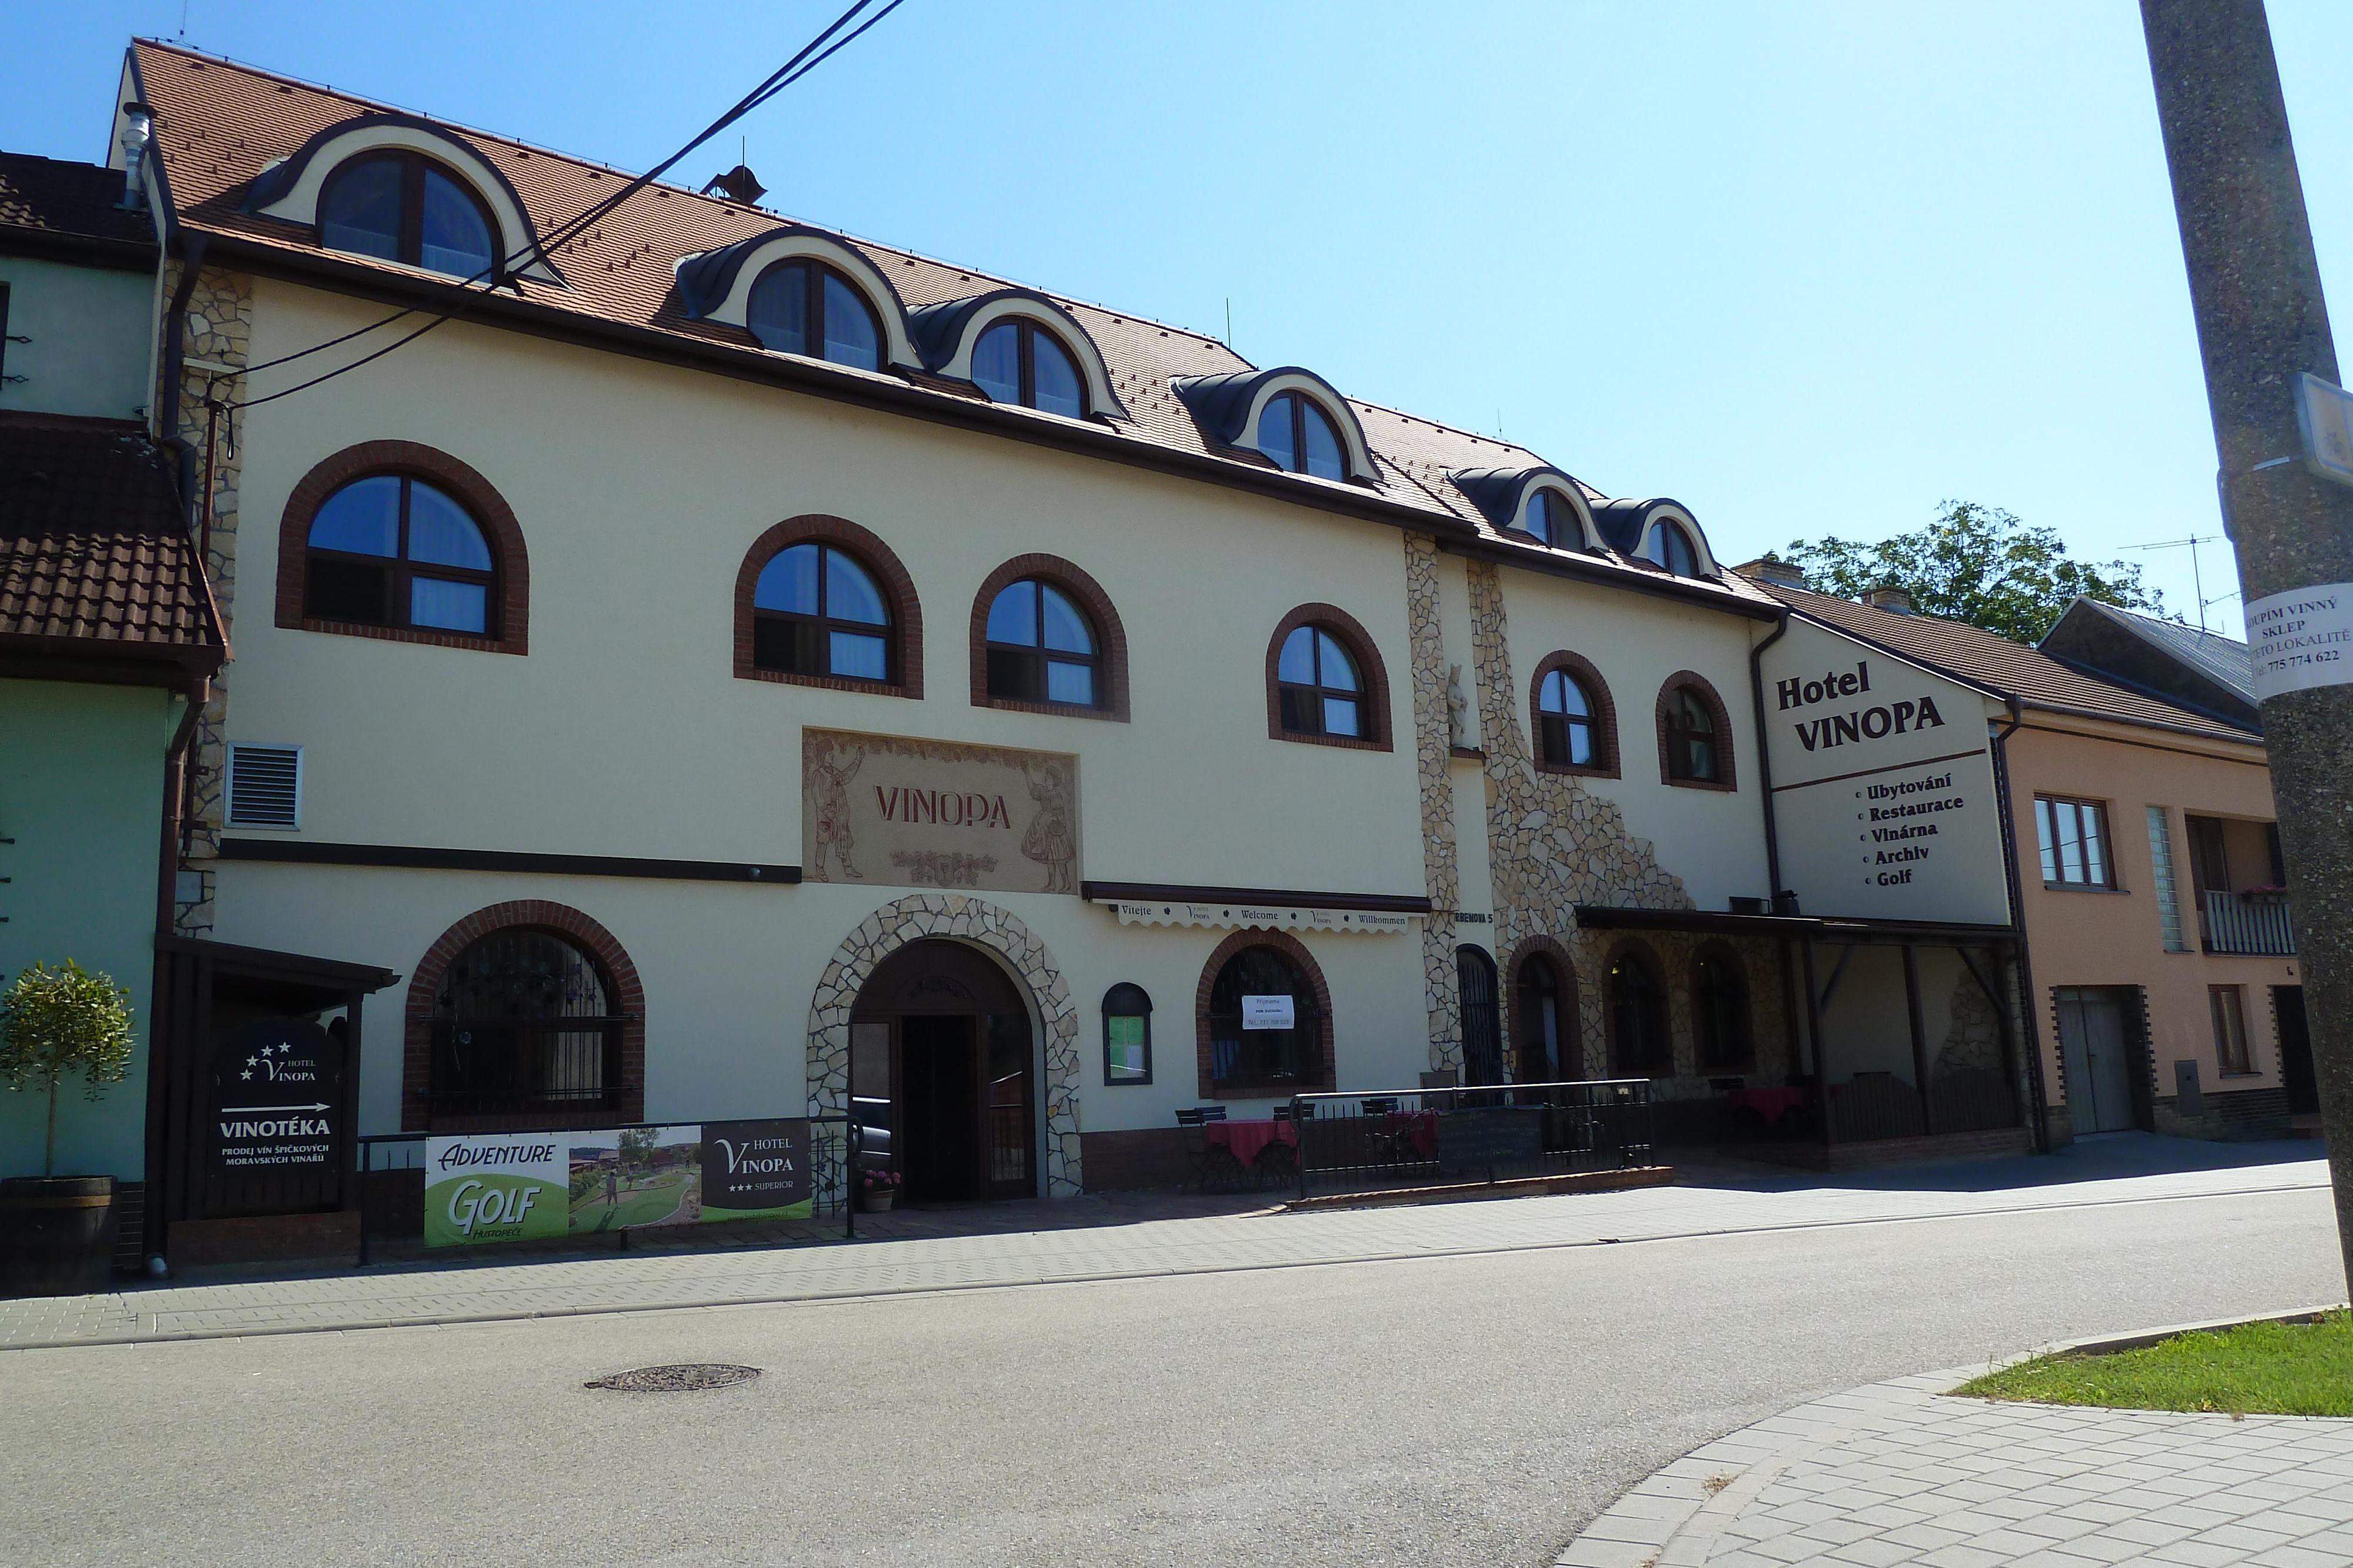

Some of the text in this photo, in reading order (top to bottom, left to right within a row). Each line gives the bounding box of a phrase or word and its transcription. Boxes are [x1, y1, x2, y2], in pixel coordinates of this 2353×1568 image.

[2287, 596, 2338, 614] VINNÝ
[2262, 620, 2305, 639] SKLEP
[2277, 628, 2351, 652] LOKALITĚ
[2268, 659, 2286, 672] 775
[2289, 654, 2311, 667] 774
[2316, 650, 2339, 662] 622
[1777, 660, 1871, 710] Hotel
[1794, 695, 1946, 752] VINOPA
[1867, 772, 1952, 800] Ubytování
[873, 785, 1011, 829] VINOPA
[1869, 797, 1964, 822] Restaurace
[1871, 824, 1939, 843] Vinárna
[1875, 846, 1929, 865] Archiv
[1877, 869, 1912, 886] Golf
[1241, 910, 1278, 920] Welcome
[1359, 915, 1405, 925] Willkommen
[1454, 912, 1493, 923] RBENOVA 5
[260, 1059, 316, 1081] VINOPA
[220, 1115, 331, 1137] VINOTÉKA
[222, 1143, 329, 1156] PRODEJ VÍN ŠPIČKOVÝCH
[754, 1138, 792, 1150] HOTEL
[226, 1153, 324, 1166] MORAVSKÝCH VINAŘŮ
[438, 1143, 556, 1171] ADVENTURE
[713, 1139, 794, 1174] VINOPA
[755, 1180, 794, 1191] SUPERIOR
[448, 1179, 542, 1236] GOLF
[472, 1227, 523, 1239] HUSTOPEČE
